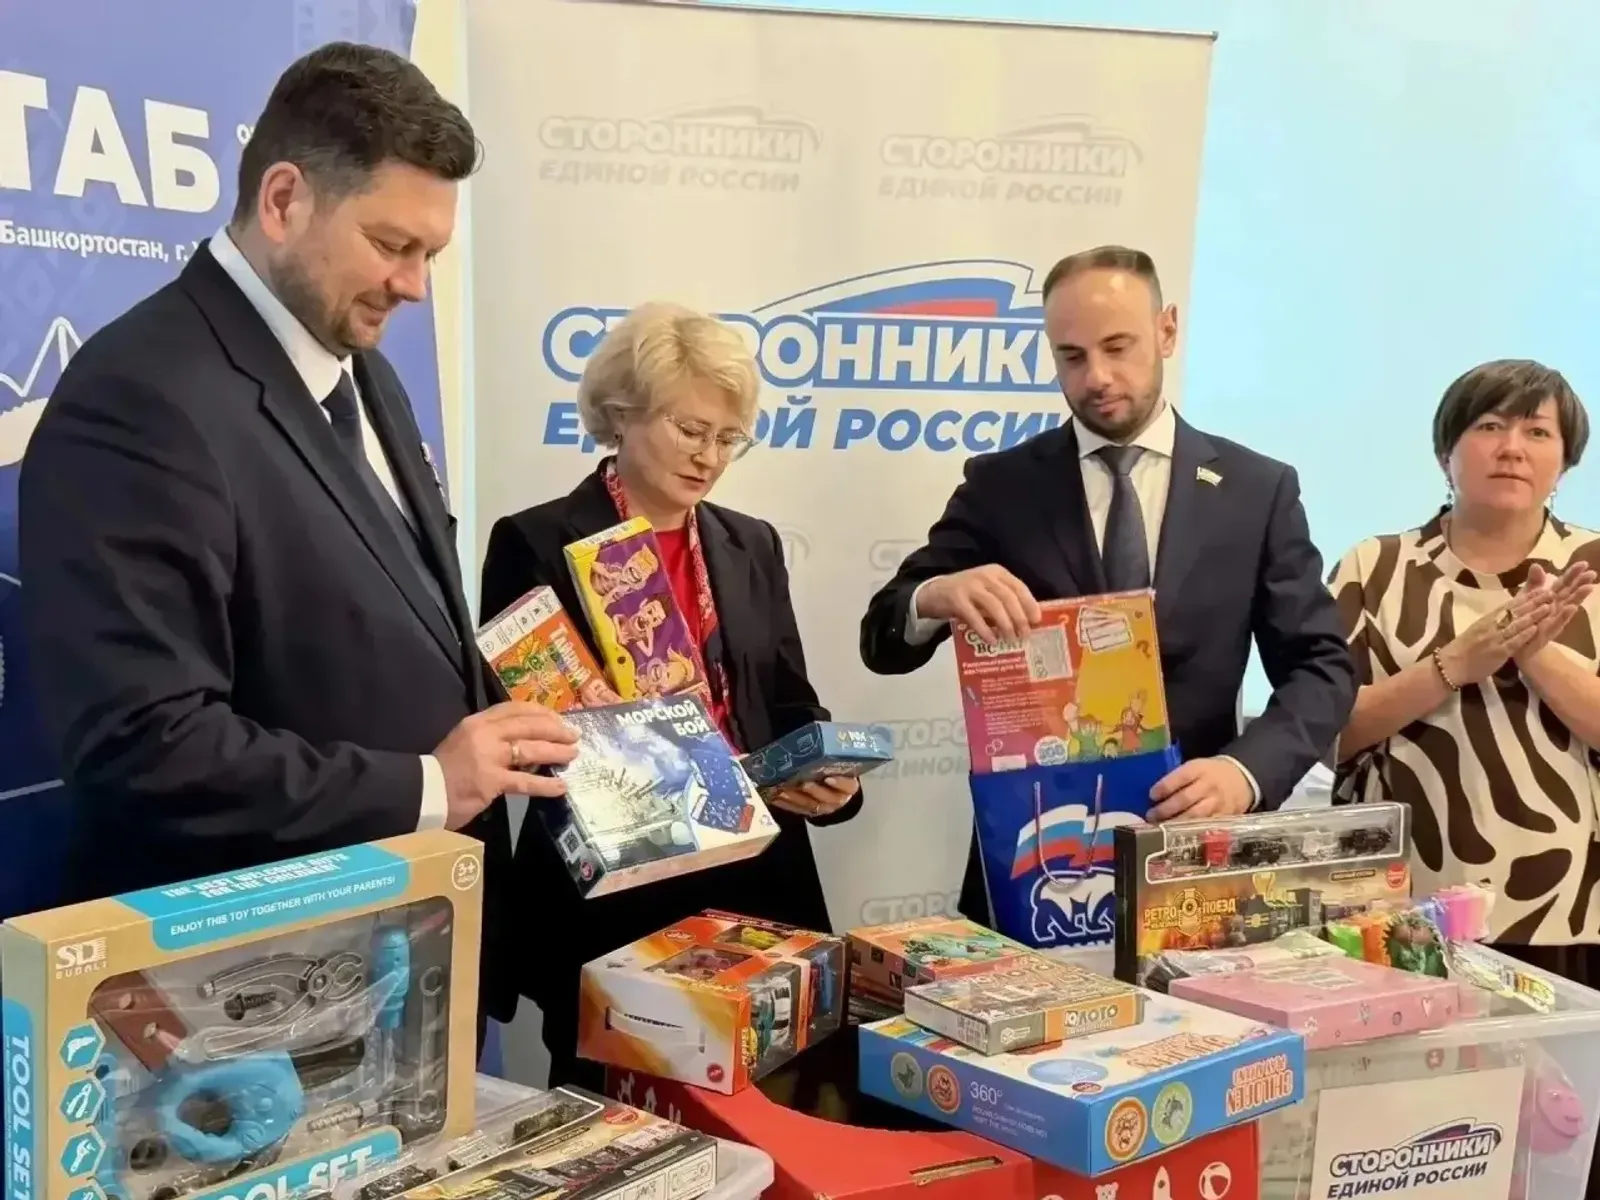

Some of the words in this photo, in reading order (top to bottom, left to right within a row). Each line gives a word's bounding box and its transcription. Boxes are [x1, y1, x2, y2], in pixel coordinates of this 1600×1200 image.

[538, 115, 803, 163] СТОРОННИКИ
[879, 133, 1127, 177] СТОРОННИКИ
[539, 159, 672, 186] ЕДИНОЙ
[679, 165, 800, 192] РОССИИ
[878, 174, 998, 201] ЕДИНОЙ
[1005, 181, 1123, 206] РОССИИ
[0, 218, 169, 263] Башкортостан,
[616, 699, 700, 728] МОРСКОЙ
[672, 715, 711, 737] БОЙ
[457, 861, 476, 877] 3+
[170, 920, 204, 936] ENJOY
[206, 913, 228, 928] THIS
[230, 908, 250, 923] TOY
[251, 896, 302, 918] TOGETHER
[303, 891, 326, 906] WITH
[328, 886, 352, 901] YOUR
[353, 875, 397, 893] PARENTS!
[1144, 906, 1177, 921] РЕТРО
[1202, 897, 1237, 914] ПОЕЗД
[12, 1035, 31, 1133] TOOL
[970, 1081, 1003, 1105] 360°
[1329, 1133, 1493, 1178] СТОРОННИКИ
[1327, 1172, 1409, 1200] ЕДИНОЙ
[1413, 1161, 1489, 1187] РОССИИ
